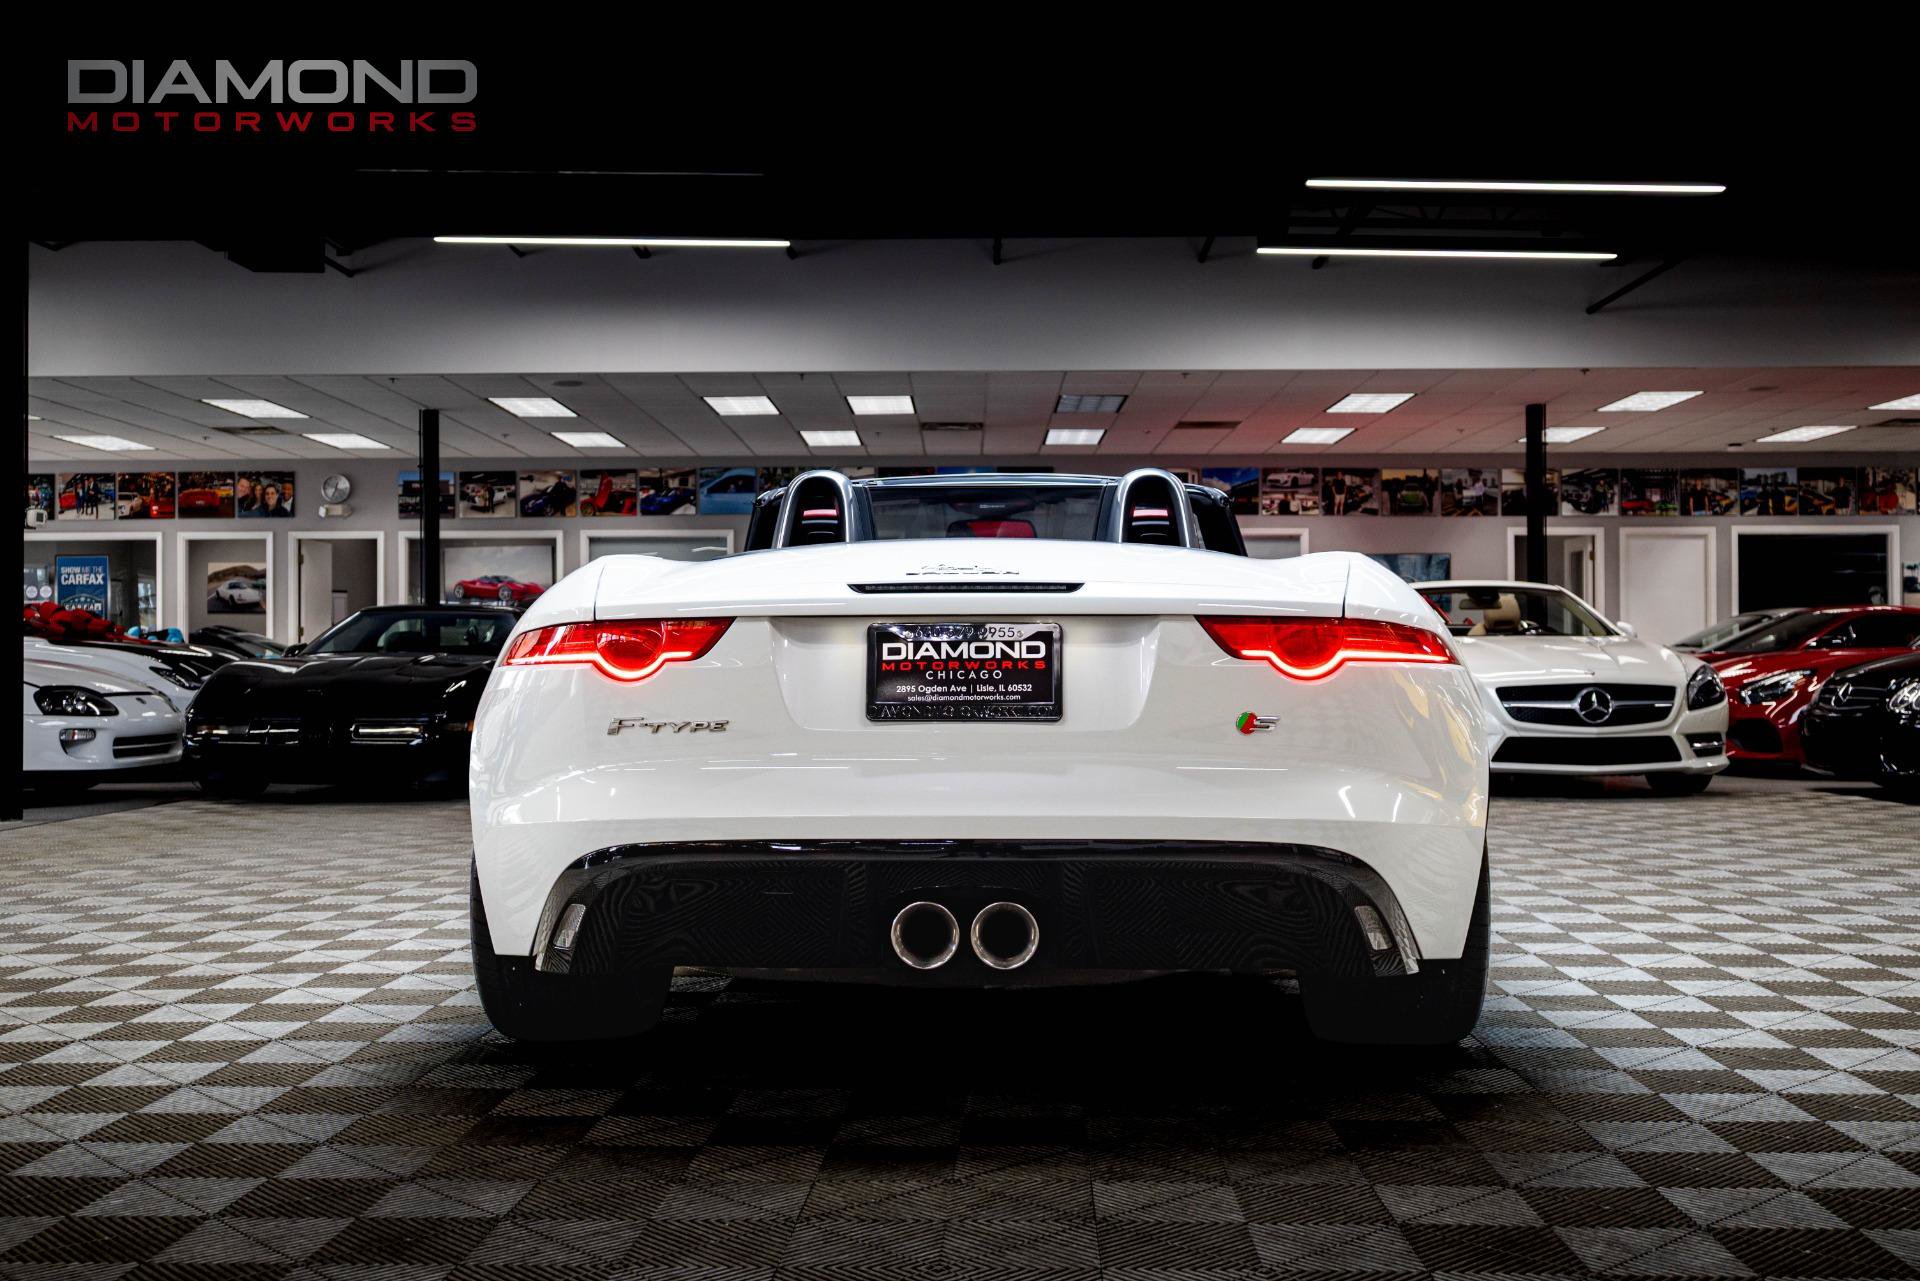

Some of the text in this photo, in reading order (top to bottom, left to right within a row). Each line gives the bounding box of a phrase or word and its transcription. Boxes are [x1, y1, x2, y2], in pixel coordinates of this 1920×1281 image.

[61, 566, 81, 574] SHOW
[61, 574, 104, 585] CARFAX
[882, 641, 1046, 661] DIAMOND
[881, 660, 1046, 671] MOTORWORKS
[925, 670, 1002, 680] CHICAGO
[896, 685, 916, 693] 2895
[918, 685, 948, 694] Ogden
[976, 684, 997, 692] Lisle,
[998, 684, 1006, 692] IL
[1007, 684, 1033, 692] 60532
[907, 694, 1021, 702] sales@diamondmotorworks.com
